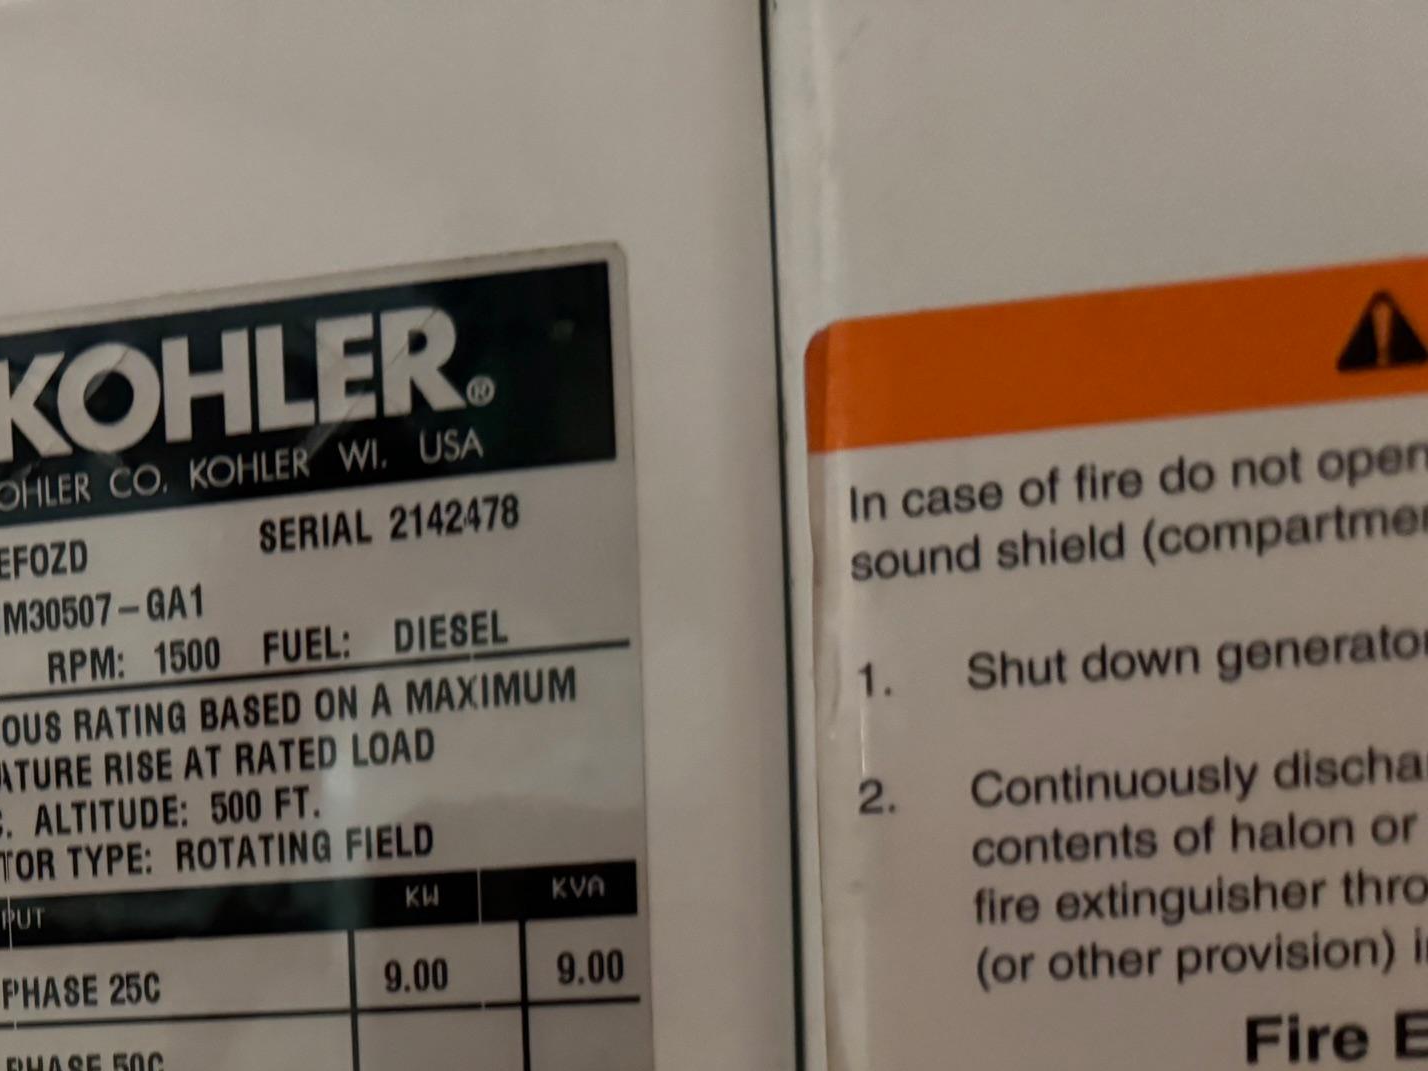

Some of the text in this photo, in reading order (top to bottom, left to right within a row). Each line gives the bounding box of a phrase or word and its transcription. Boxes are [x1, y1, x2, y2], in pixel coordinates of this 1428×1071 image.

[109, 465, 168, 499] CO.
[189, 450, 310, 490] KOHLER
[338, 438, 386, 472] WI.
[419, 430, 484, 464] USA
[851, 486, 886, 522] In
[901, 479, 1003, 520] case
[1019, 467, 1061, 508] of
[1075, 462, 1143, 503] fire
[1159, 455, 1216, 495] do
[1232, 446, 1302, 487] not
[259, 494, 519, 554] SERIAL 2142478
[851, 523, 1124, 582] sound shield
[47, 646, 124, 684] RPM:
[154, 637, 220, 674] 1500
[263, 626, 350, 666] FUEL:
[394, 610, 508, 653] DIESEL
[859, 641, 1200, 697] 1. Shut down
[74, 701, 187, 742] RATING
[200, 691, 301, 733] BASED
[314, 685, 358, 721] ON
[372, 682, 392, 717] A
[405, 667, 576, 712] MAXIMUM
[103, 745, 173, 785] RISE
[183, 742, 222, 778] AT
[235, 733, 338, 776] RATED
[351, 726, 435, 768] LOAD
[859, 755, 1258, 815] 2. Continuously
[34, 793, 189, 838] ALTITUDE:
[210, 790, 262, 825] 500
[274, 786, 321, 821] FT.
[972, 812, 1418, 867] contents of halon or
[67, 841, 153, 879] TYPE:
[175, 829, 332, 874] ROTATING
[346, 823, 435, 863] FIELD
[405, 884, 440, 908] KW
[552, 875, 605, 900] KVA
[974, 874, 1327, 926] fire extinguisher
[2, 973, 98, 1010] PHASE
[109, 971, 161, 1005] 25C
[384, 957, 449, 993] 9.00
[557, 948, 625, 985] 9.00
[976, 949, 1034, 993] (or
[1048, 940, 1161, 981] other
[1176, 929, 1396, 985] provision)
[1246, 1013, 1369, 1064] Fire
